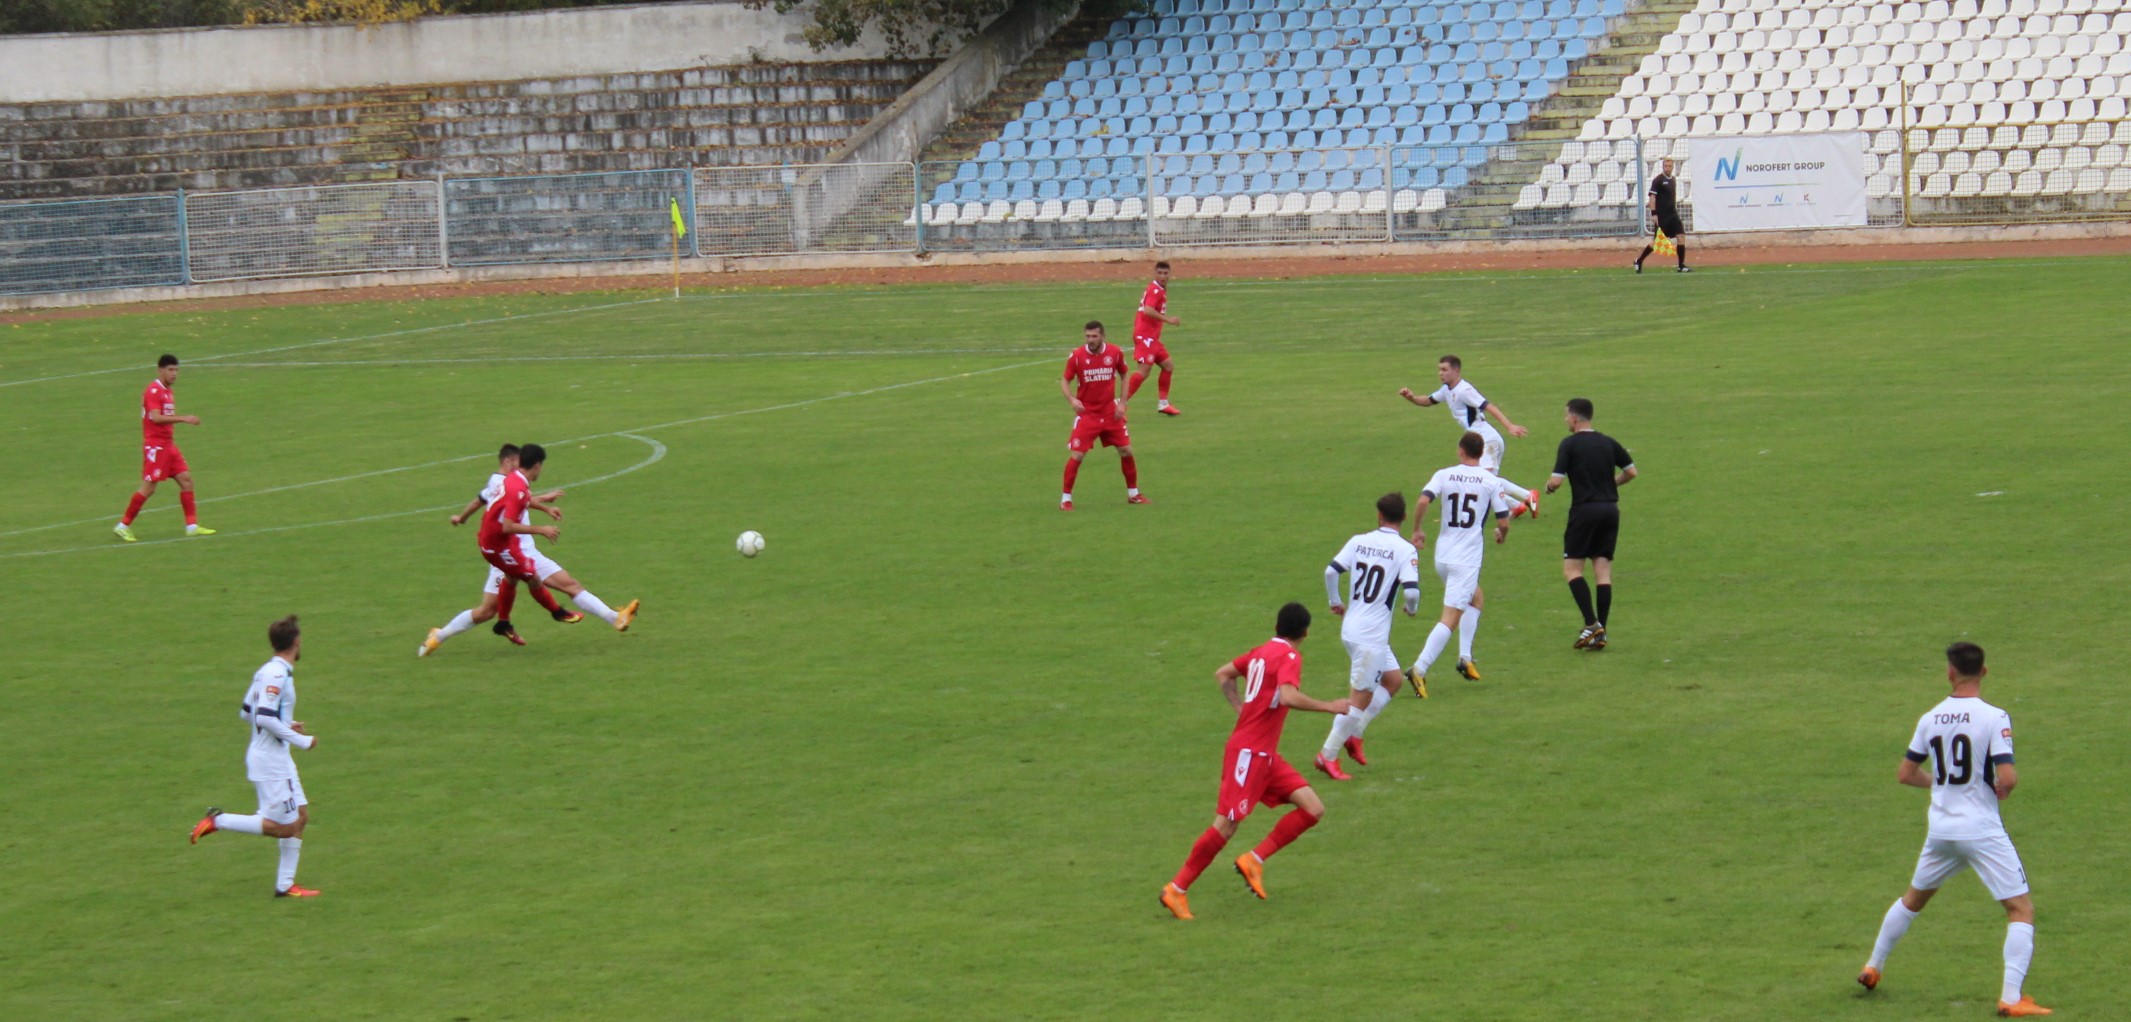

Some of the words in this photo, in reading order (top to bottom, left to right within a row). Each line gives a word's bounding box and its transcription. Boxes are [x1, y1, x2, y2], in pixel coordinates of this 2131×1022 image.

[1746, 162, 1791, 173] NOROFERT
[1794, 161, 1826, 171] GROUP
[1449, 474, 1483, 484] ANTON
[1447, 492, 1479, 529] 15
[1352, 561, 1386, 604] 20
[1934, 712, 1970, 725] TOMA
[1929, 733, 1973, 786] 19
